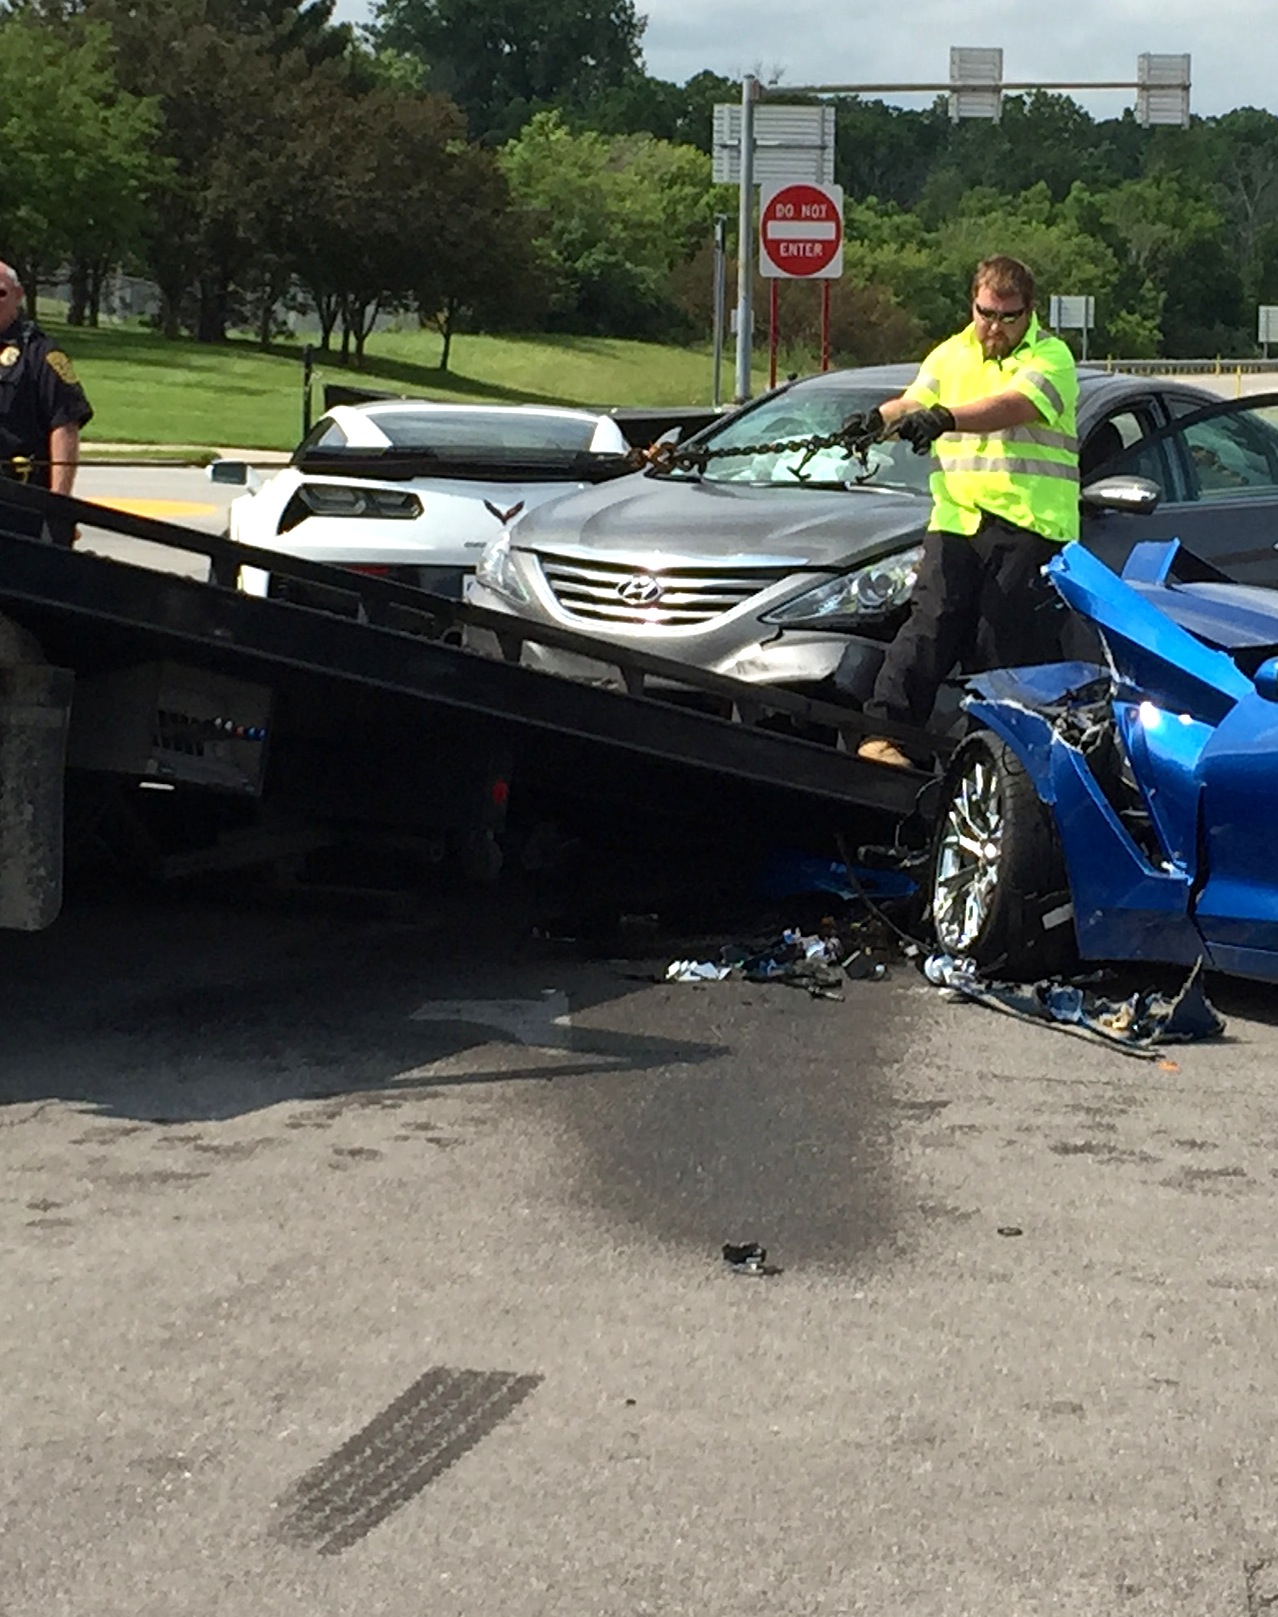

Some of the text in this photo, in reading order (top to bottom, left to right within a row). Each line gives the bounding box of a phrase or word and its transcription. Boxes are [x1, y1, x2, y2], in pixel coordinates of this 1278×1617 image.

[775, 203, 828, 218] DO NOT
[780, 243, 823, 257] ENTER
